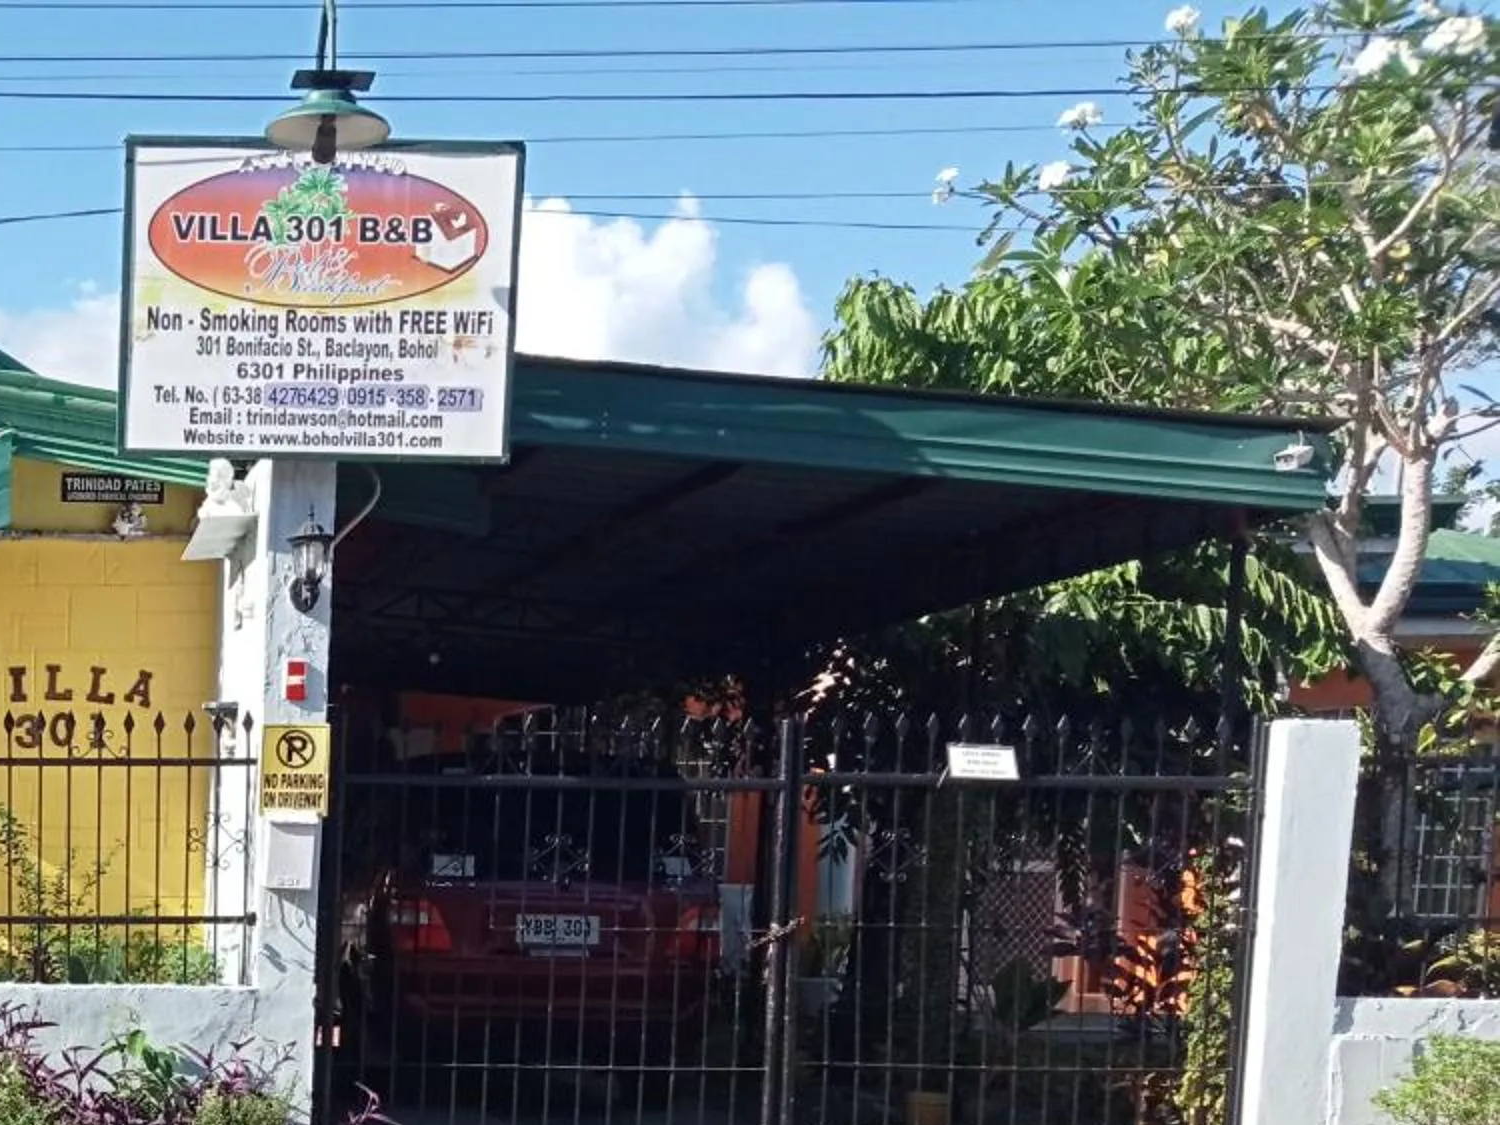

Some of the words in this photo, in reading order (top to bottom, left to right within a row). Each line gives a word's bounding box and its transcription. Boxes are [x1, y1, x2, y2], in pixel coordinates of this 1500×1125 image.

[172, 214, 273, 242] VILLA
[287, 214, 343, 242] 301
[359, 216, 433, 244] B&B
[147, 306, 183, 331] Non
[199, 307, 278, 338] Smoking
[285, 309, 347, 333] Rooms
[353, 309, 393, 333] with
[400, 311, 447, 334] FREE
[453, 310, 494, 335] WiFi
[196, 335, 220, 356] 301
[226, 336, 293, 358] Bonifacio
[325, 338, 393, 362] Baclayon,
[399, 338, 439, 359] Bohol
[237, 362, 284, 379] 6301
[293, 362, 405, 385] Philippines
[154, 385, 180, 403] Tel.
[184, 386, 208, 403] No.
[267, 387, 340, 407] 4276429
[189, 407, 232, 425] Email
[183, 428, 244, 445] Website
[259, 430, 443, 449] www.boholvilla301.com
[66, 477, 122, 491] TRINIDAD
[14, 711, 106, 749] 301
[263, 773, 278, 789] NO
[281, 773, 324, 789] PARKING
[263, 791, 277, 808] ON
[278, 791, 323, 809] DRIVEWAY
